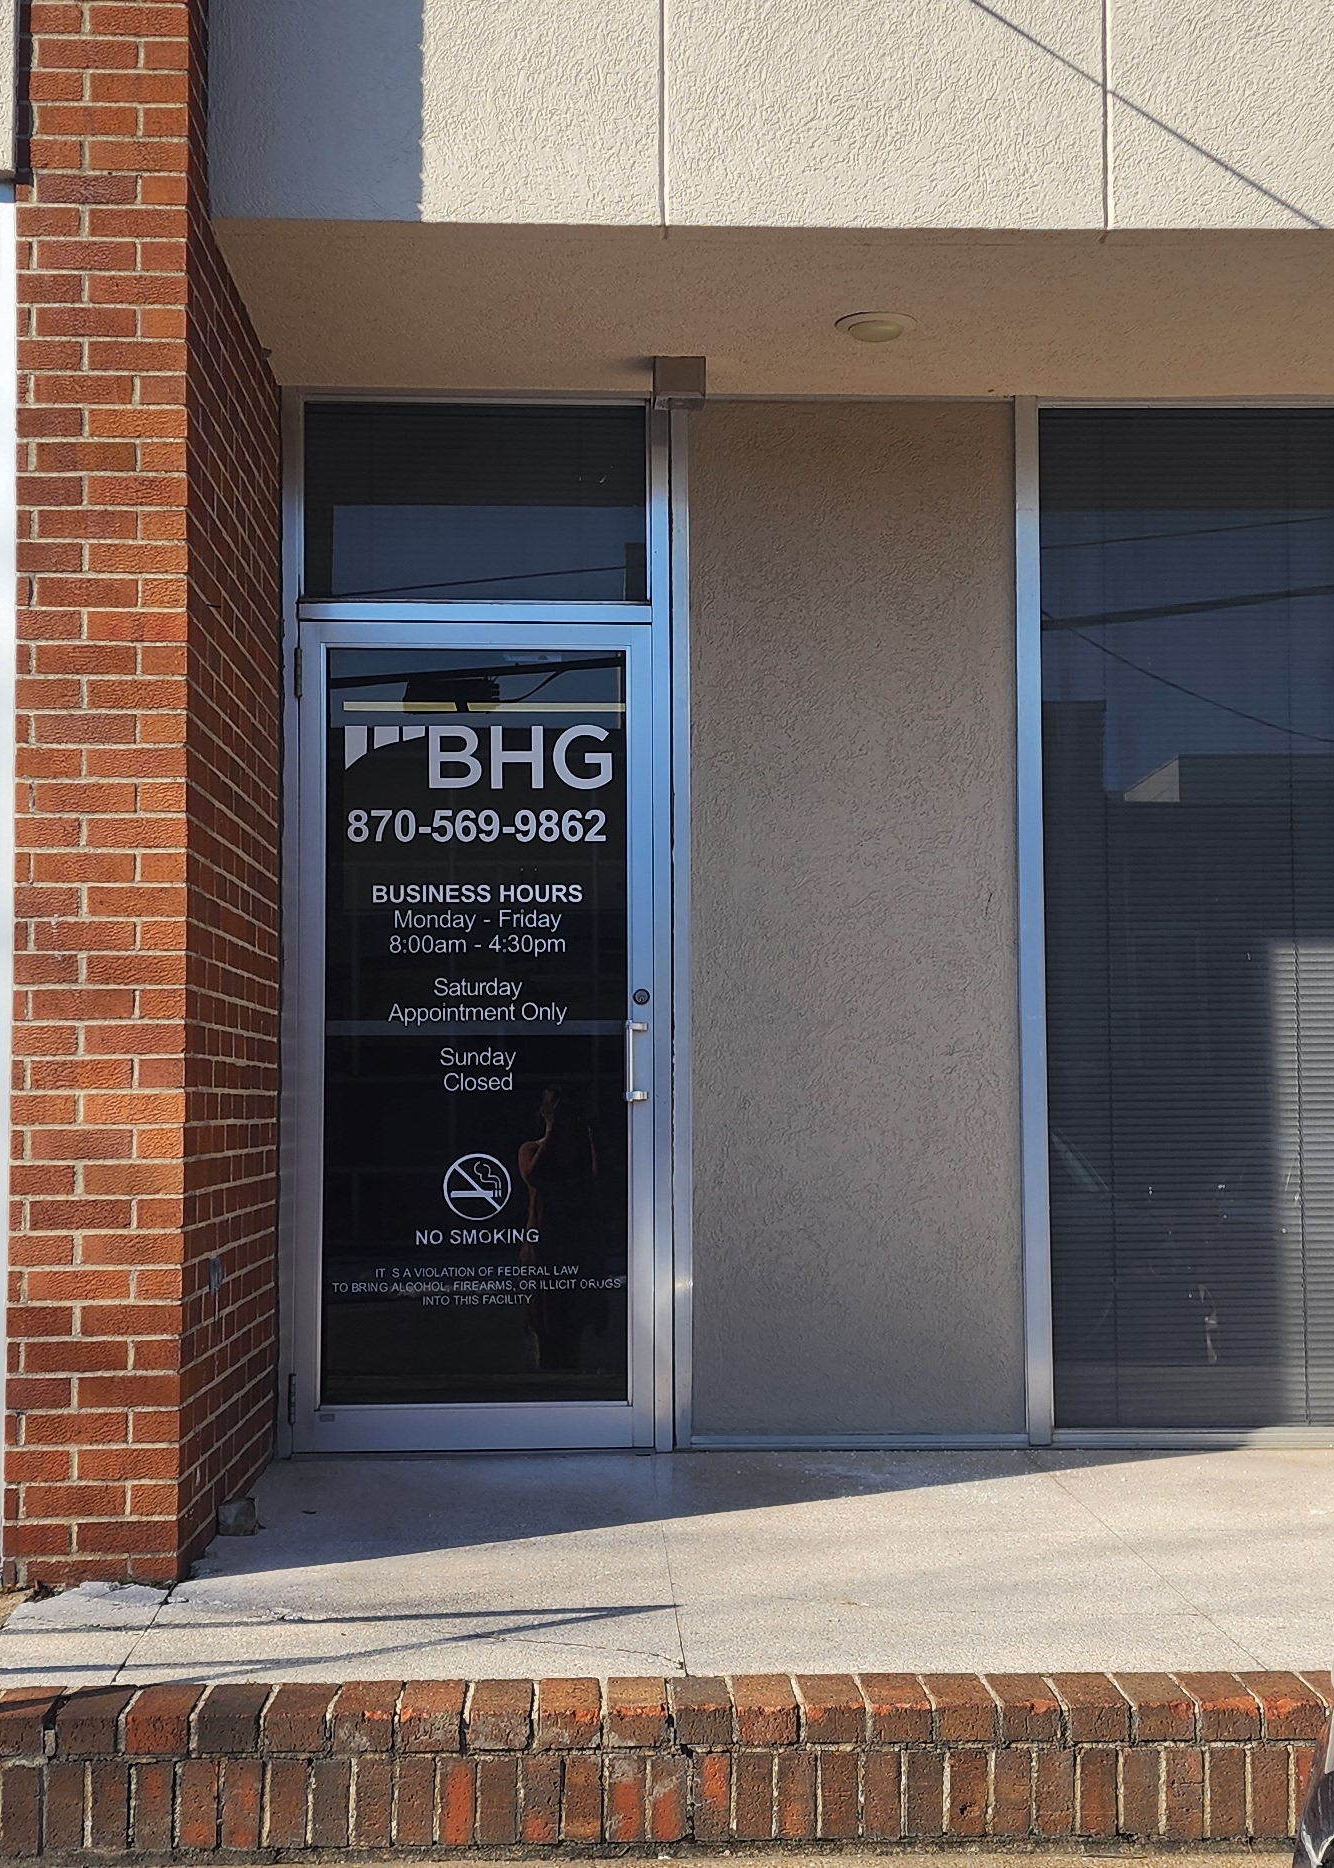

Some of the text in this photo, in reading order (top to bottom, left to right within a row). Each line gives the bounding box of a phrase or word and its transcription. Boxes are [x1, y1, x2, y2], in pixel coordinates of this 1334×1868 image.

[428, 724, 613, 790] BHG
[346, 808, 607, 843] 870-569-9862
[372, 884, 584, 903] BUSINESS HOURS
[394, 910, 477, 933] Monday
[499, 909, 562, 932] Friday
[389, 935, 467, 954] 8:00am
[488, 935, 566, 957] 4:30pm
[433, 977, 523, 1000] Saturday
[388, 1002, 568, 1026] Appointment Only
[440, 1047, 517, 1070] Sunday
[443, 1072, 514, 1091] Closed
[415, 1228, 540, 1245] NO SMOKING
[375, 1267, 386, 1278] IT
[402, 1267, 413, 1278] A
[413, 1266, 475, 1278] VIOLATION
[478, 1266, 495, 1277] OF
[497, 1265, 550, 1277] FEDERAL
[553, 1265, 579, 1276] LAW
[332, 1282, 349, 1293] TO
[351, 1282, 389, 1293] BRING
[391, 1281, 450, 1294] ALCOHOL,
[453, 1280, 516, 1292] FIREARMS,
[519, 1280, 537, 1291] OR
[539, 1279, 577, 1291] ILLICIT
[422, 1293, 533, 1306] INTO THIS FACILITY
